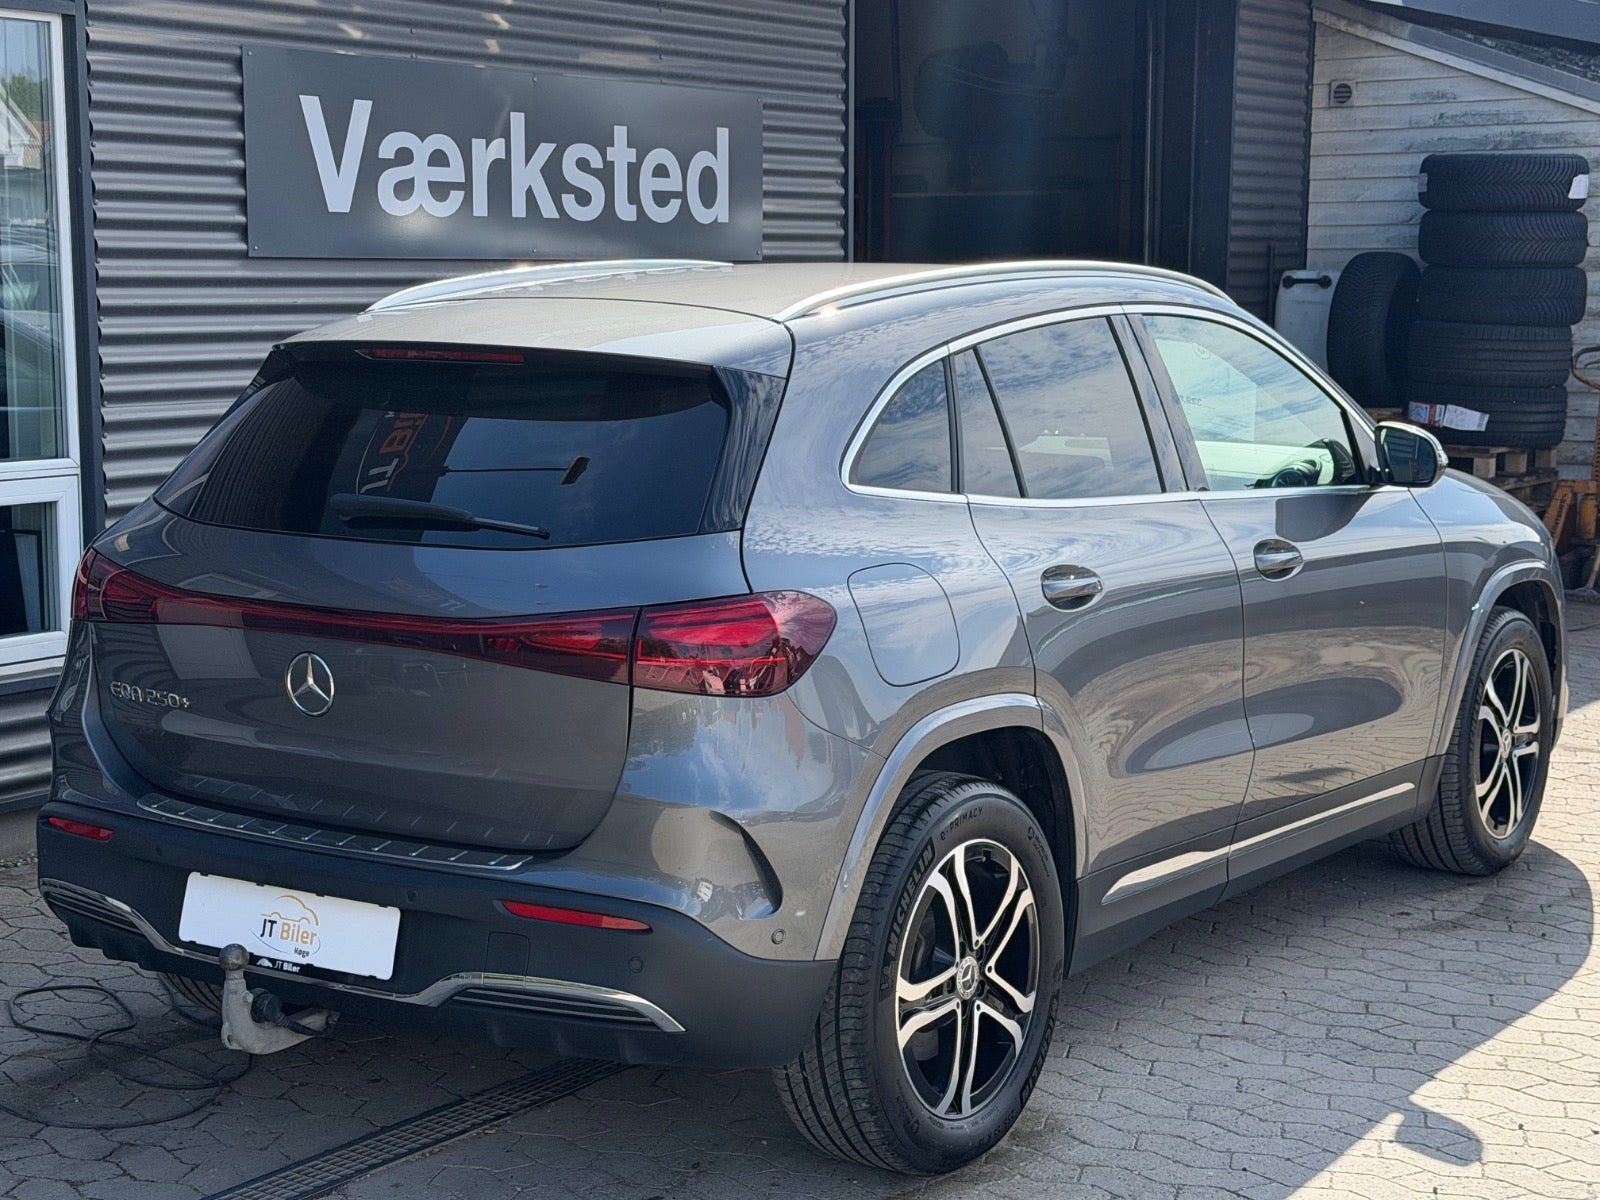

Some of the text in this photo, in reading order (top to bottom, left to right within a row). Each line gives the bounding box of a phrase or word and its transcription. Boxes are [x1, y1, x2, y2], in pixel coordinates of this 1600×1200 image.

[299, 94, 730, 225] Værksted
[110, 681, 190, 708] EQA 250+
[888, 840, 935, 957] MICHELIN
[260, 918, 317, 945] JT Biler
[274, 961, 300, 972] JT Biler
